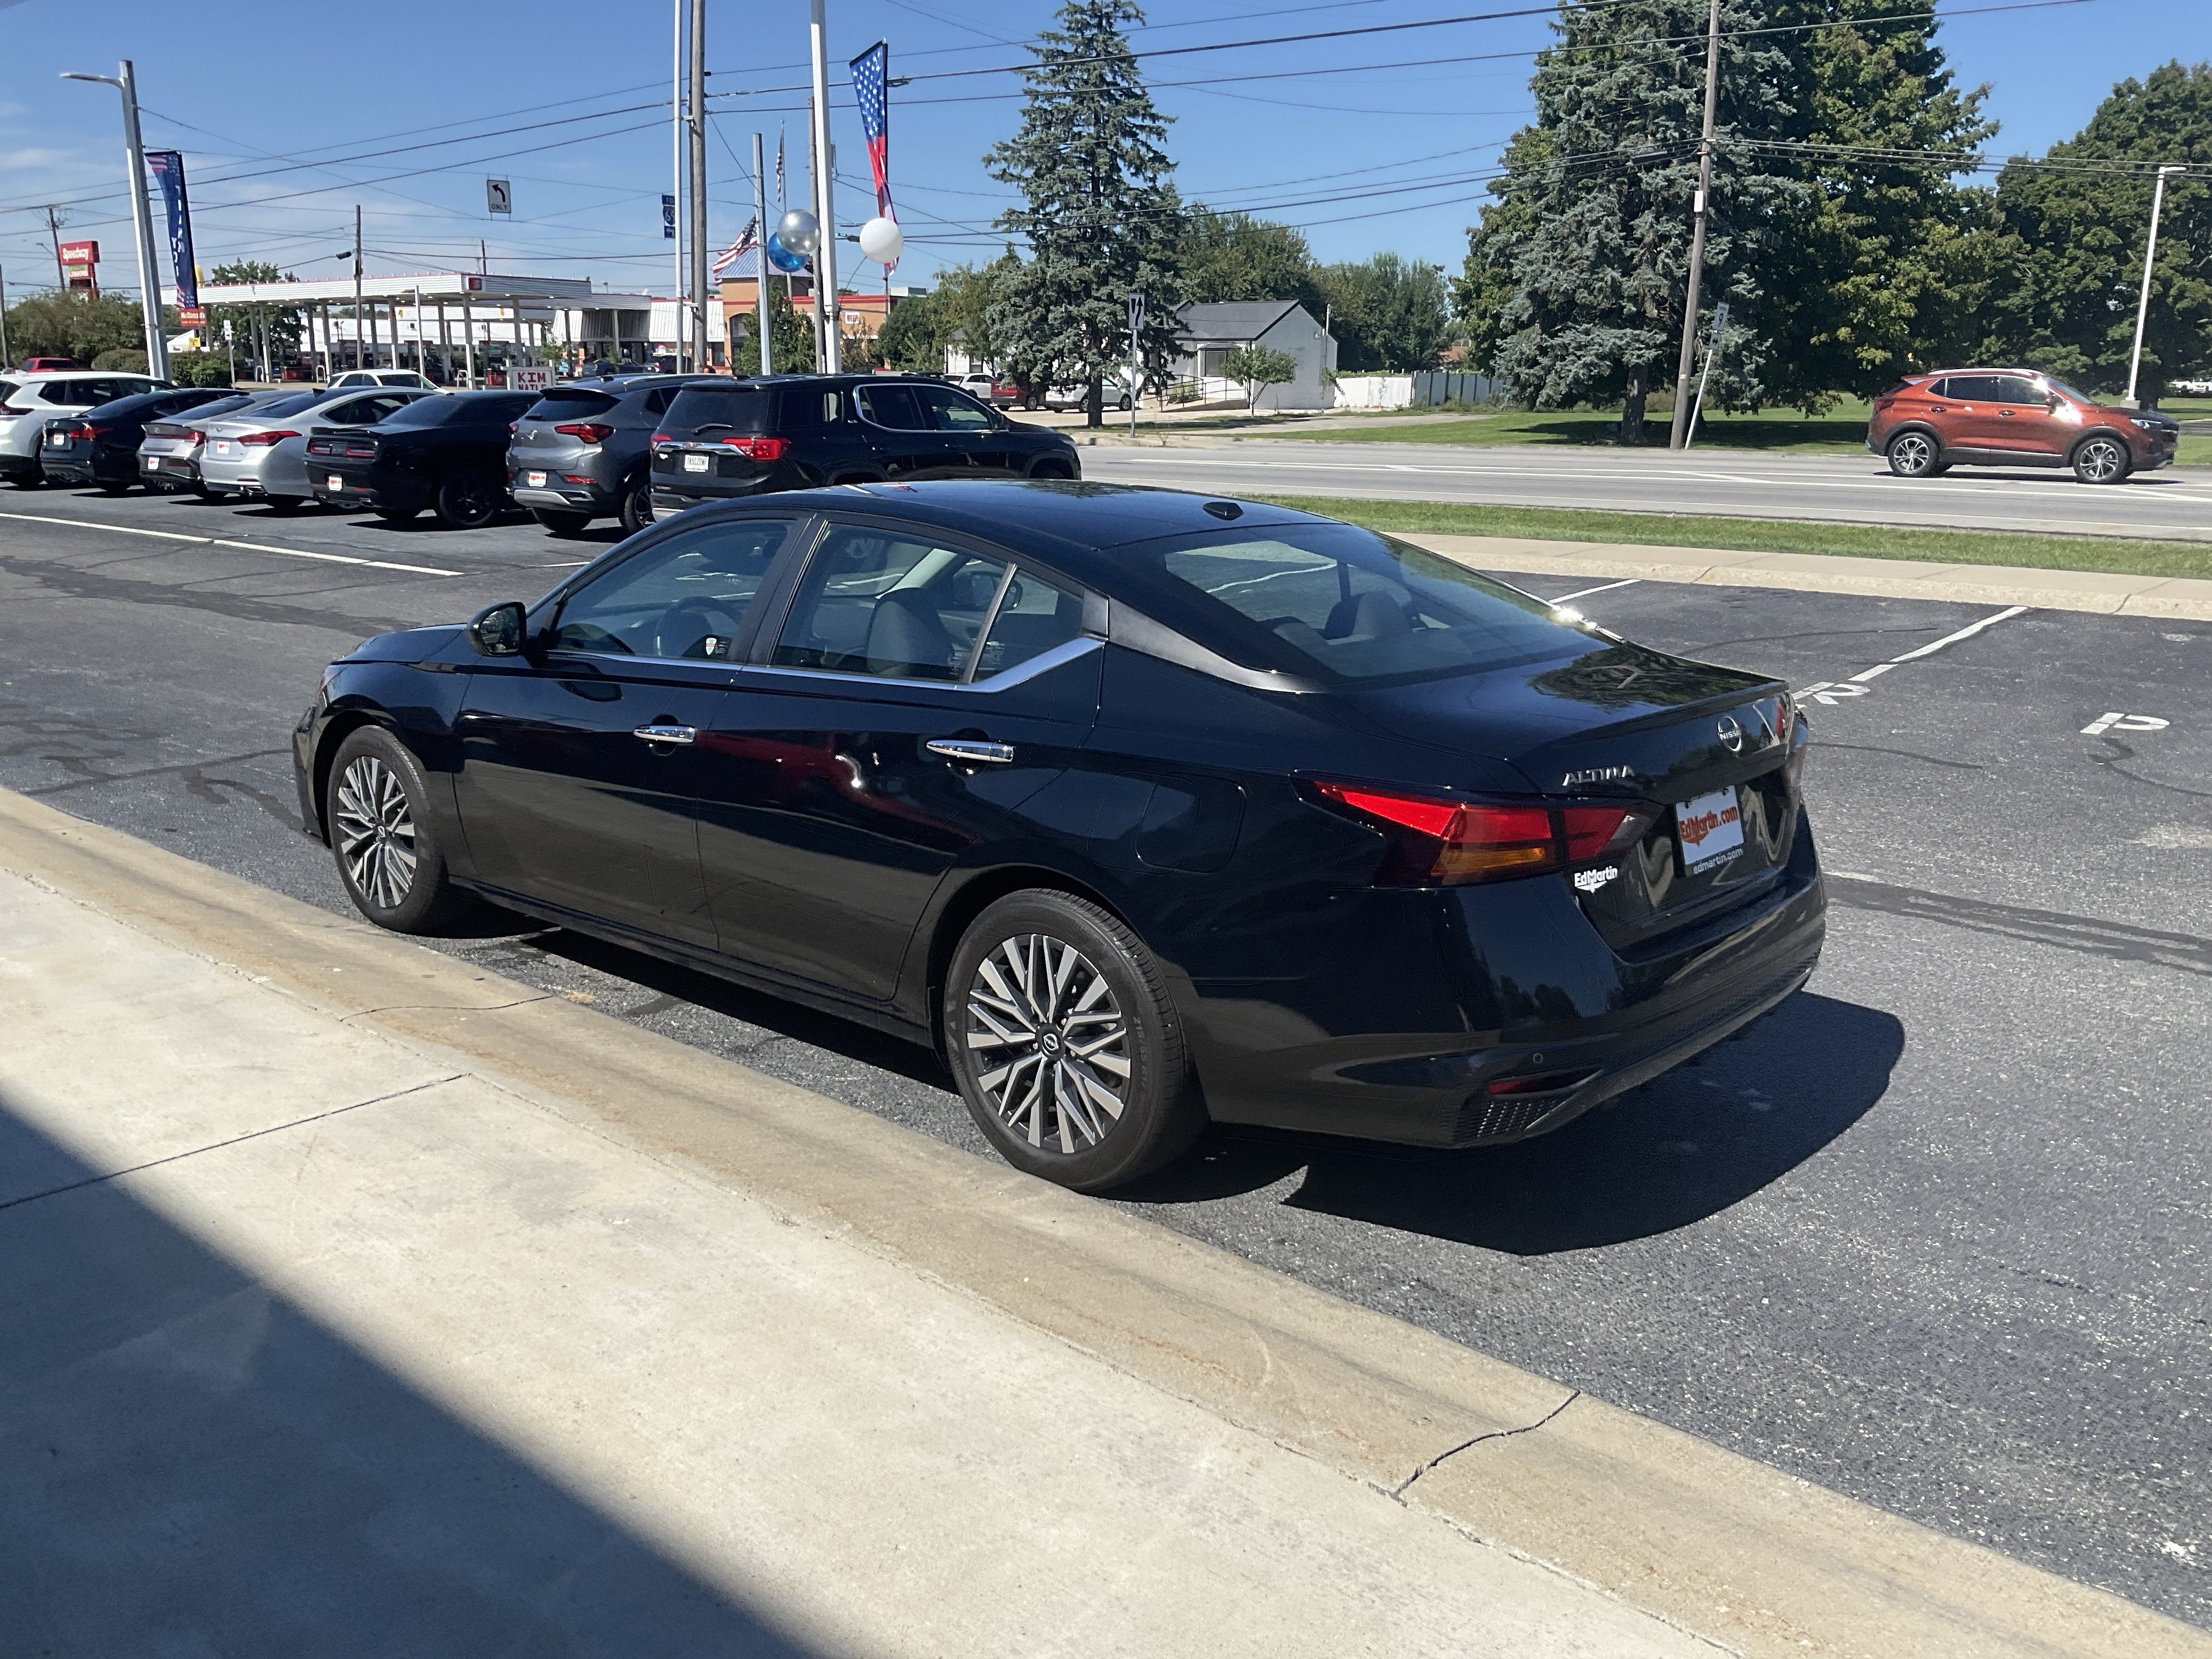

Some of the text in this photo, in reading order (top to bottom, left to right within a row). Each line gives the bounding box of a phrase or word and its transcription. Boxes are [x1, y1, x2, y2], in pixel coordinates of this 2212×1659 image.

[1718, 313, 1724, 327] 9
[517, 372, 546, 383] KIM
[1678, 806, 1739, 839] EdMartin.com
[1693, 848, 1743, 874] edmartin.com
[1574, 865, 1618, 888] EdMartin
